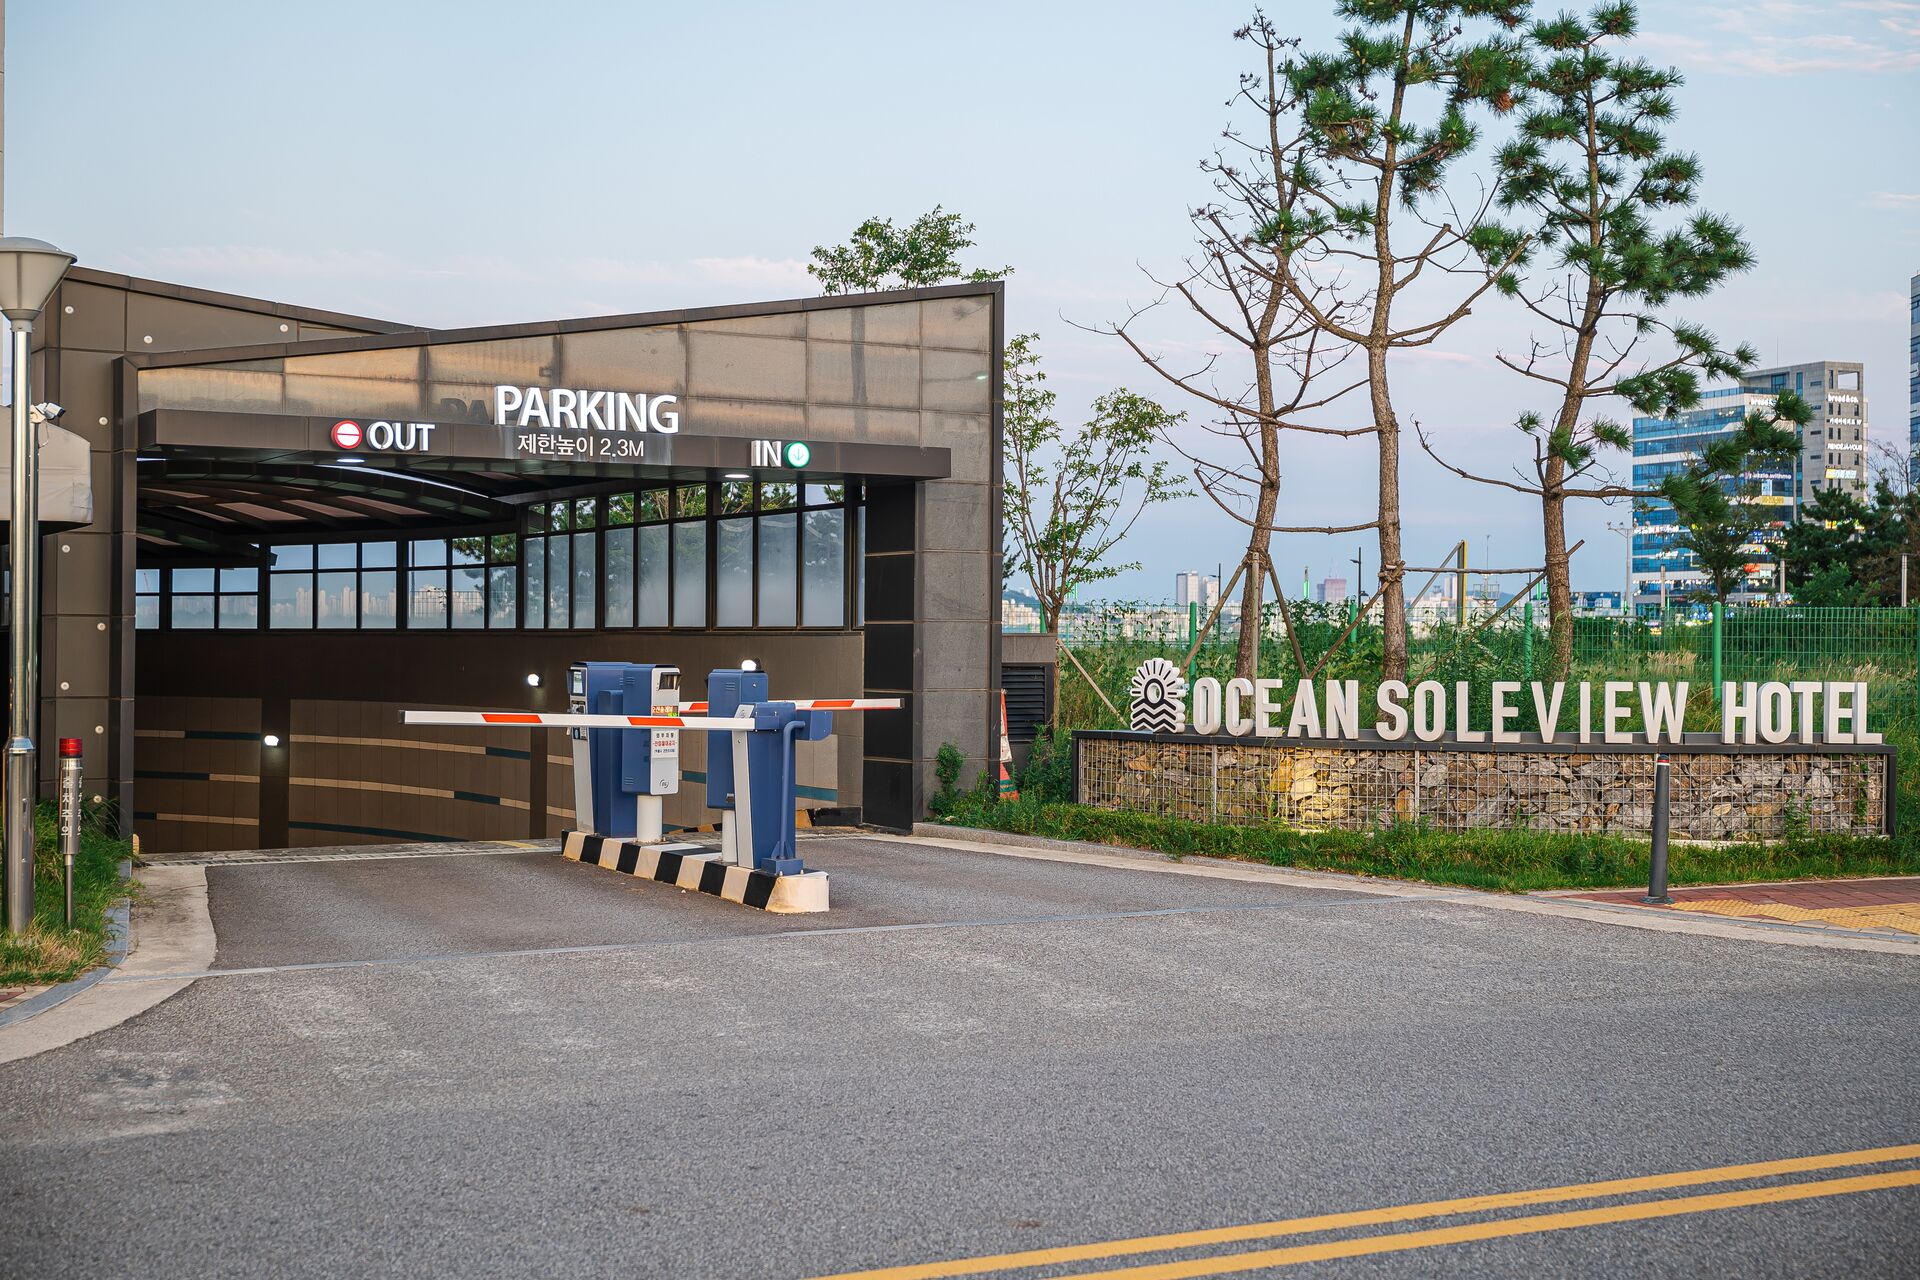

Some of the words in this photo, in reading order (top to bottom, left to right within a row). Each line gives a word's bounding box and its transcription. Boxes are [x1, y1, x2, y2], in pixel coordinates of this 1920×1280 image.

[494, 385, 679, 434] PARKING
[366, 421, 436, 451] OUT
[517, 433, 594, 456] 제한높이
[600, 438, 644, 458] 2.3M
[750, 439, 782, 467] IN
[1193, 677, 1359, 740] OCEAN
[1375, 680, 1690, 744] SOLEVIEW
[1721, 681, 1883, 745] HOTEL
